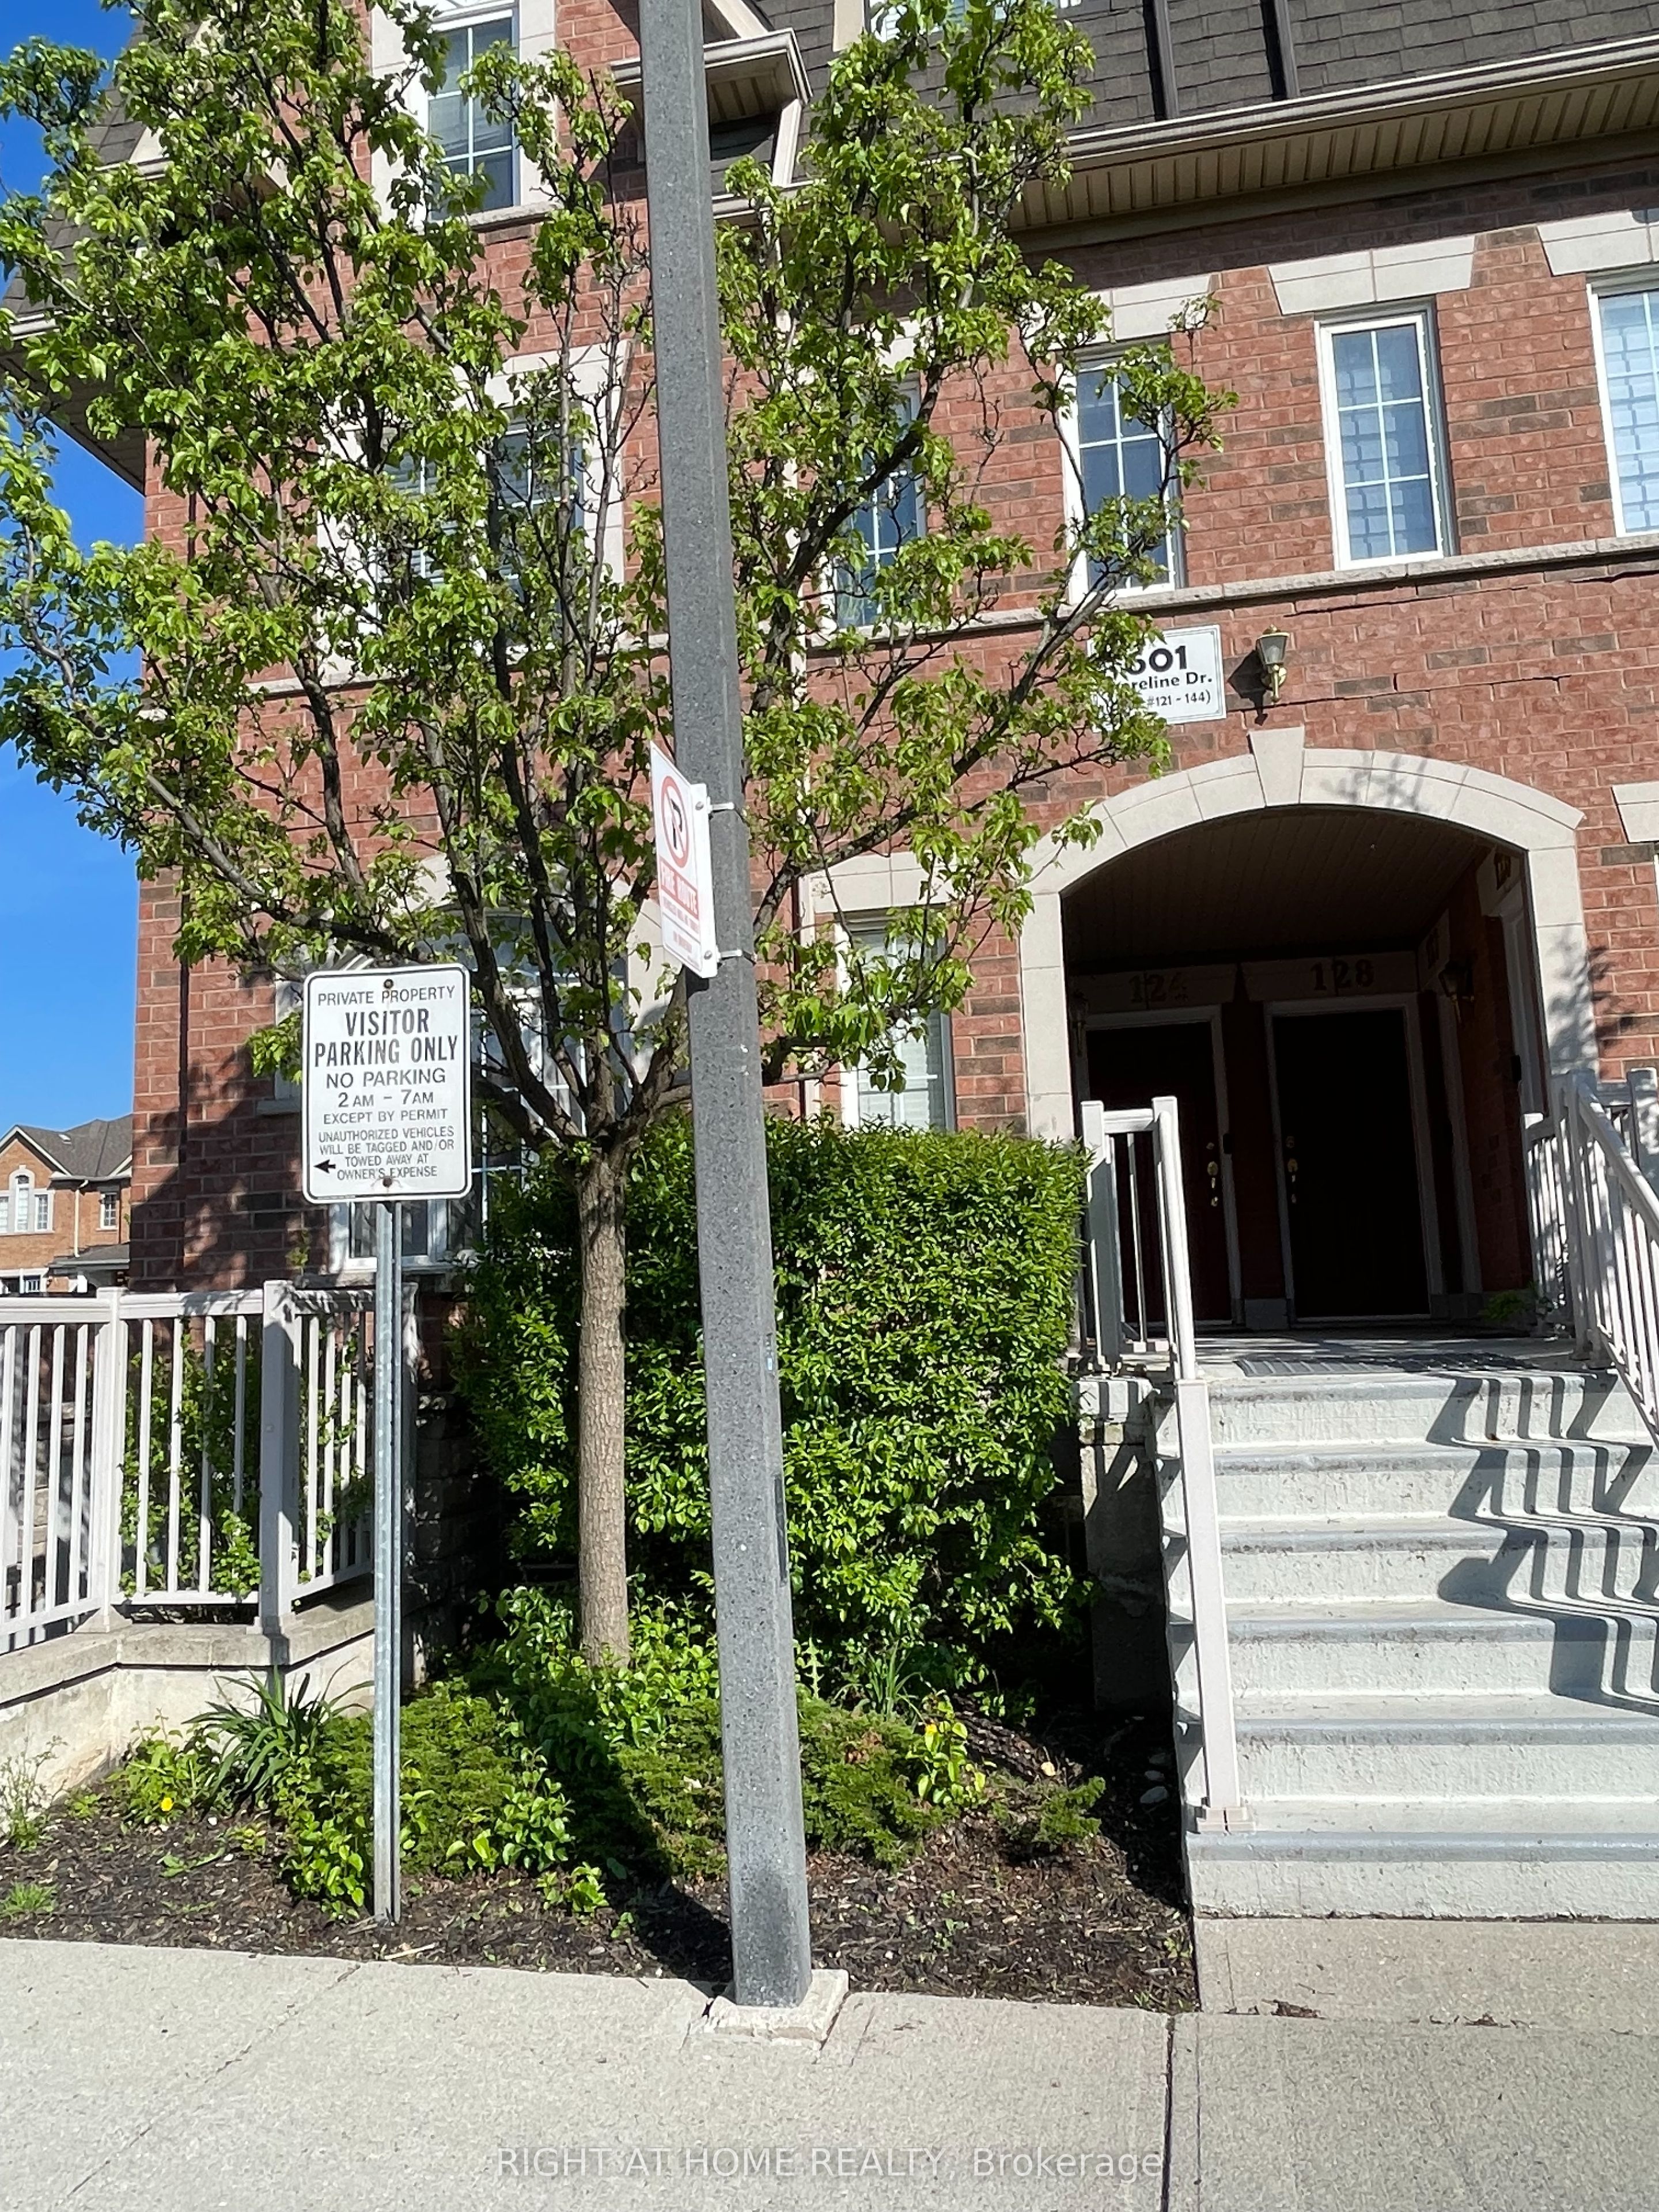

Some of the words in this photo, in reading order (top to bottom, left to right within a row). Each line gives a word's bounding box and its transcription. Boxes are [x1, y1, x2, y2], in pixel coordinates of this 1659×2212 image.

[1186, 672, 1213, 685] Dr.
[1185, 690, 1211, 704] 144)
[1310, 959, 1374, 991] 128
[318, 991, 374, 1006] PRIVATE
[381, 986, 456, 1004] PROPERTY
[346, 1008, 430, 1036] VISITOR
[315, 1038, 400, 1067] PARKING
[411, 1035, 458, 1063] ONLY
[326, 1072, 354, 1089] NO
[363, 1067, 446, 1087] PARKING
[324, 1112, 373, 1124] EXCEPT
[378, 1111, 395, 1122] BY
[400, 1108, 448, 1121] PERMIT
[318, 1128, 399, 1143] UNAUTHORIZED
[403, 1126, 454, 1139] VEHICLES
[319, 1144, 343, 1155] WILL
[348, 1143, 362, 1154] BE
[366, 1141, 407, 1153] TAGGED
[345, 1156, 382, 1168] TOWED
[386, 1154, 412, 1165] AWAY
[417, 1153, 429, 1164] AT
[337, 1168, 385, 1180] OWNER'S
[390, 1166, 438, 1179] EXPENSE
